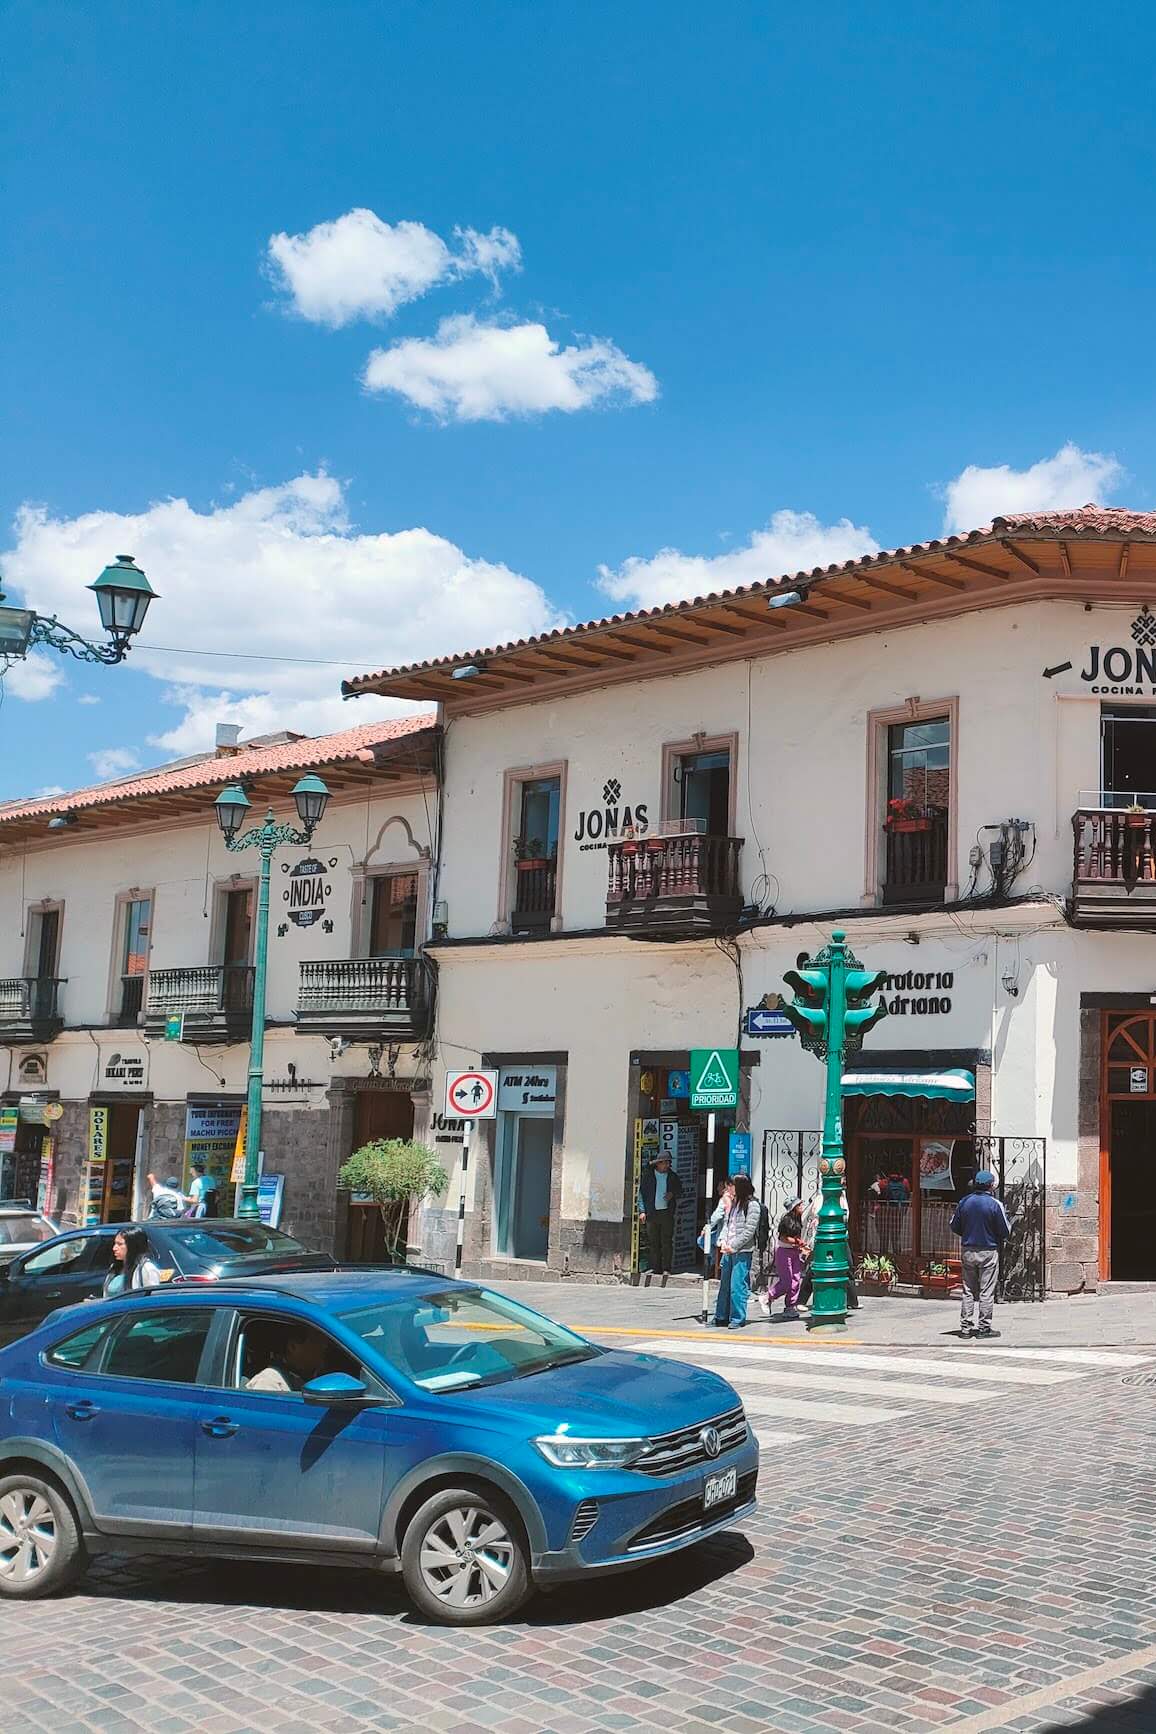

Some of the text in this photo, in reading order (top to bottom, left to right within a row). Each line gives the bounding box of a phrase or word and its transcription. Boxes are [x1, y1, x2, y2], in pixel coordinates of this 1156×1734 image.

[1091, 686, 1144, 695] COCINA
[574, 804, 649, 841] JONAS
[579, 842, 608, 852] COCINA
[290, 877, 324, 907] INDIA
[878, 994, 952, 1015] Adriano
[503, 1076, 522, 1088] ATM
[694, 1094, 735, 1104] PRIORIDAD
[93, 1111, 104, 1158] DOLARES
[190, 1130, 216, 1138] MACHU
